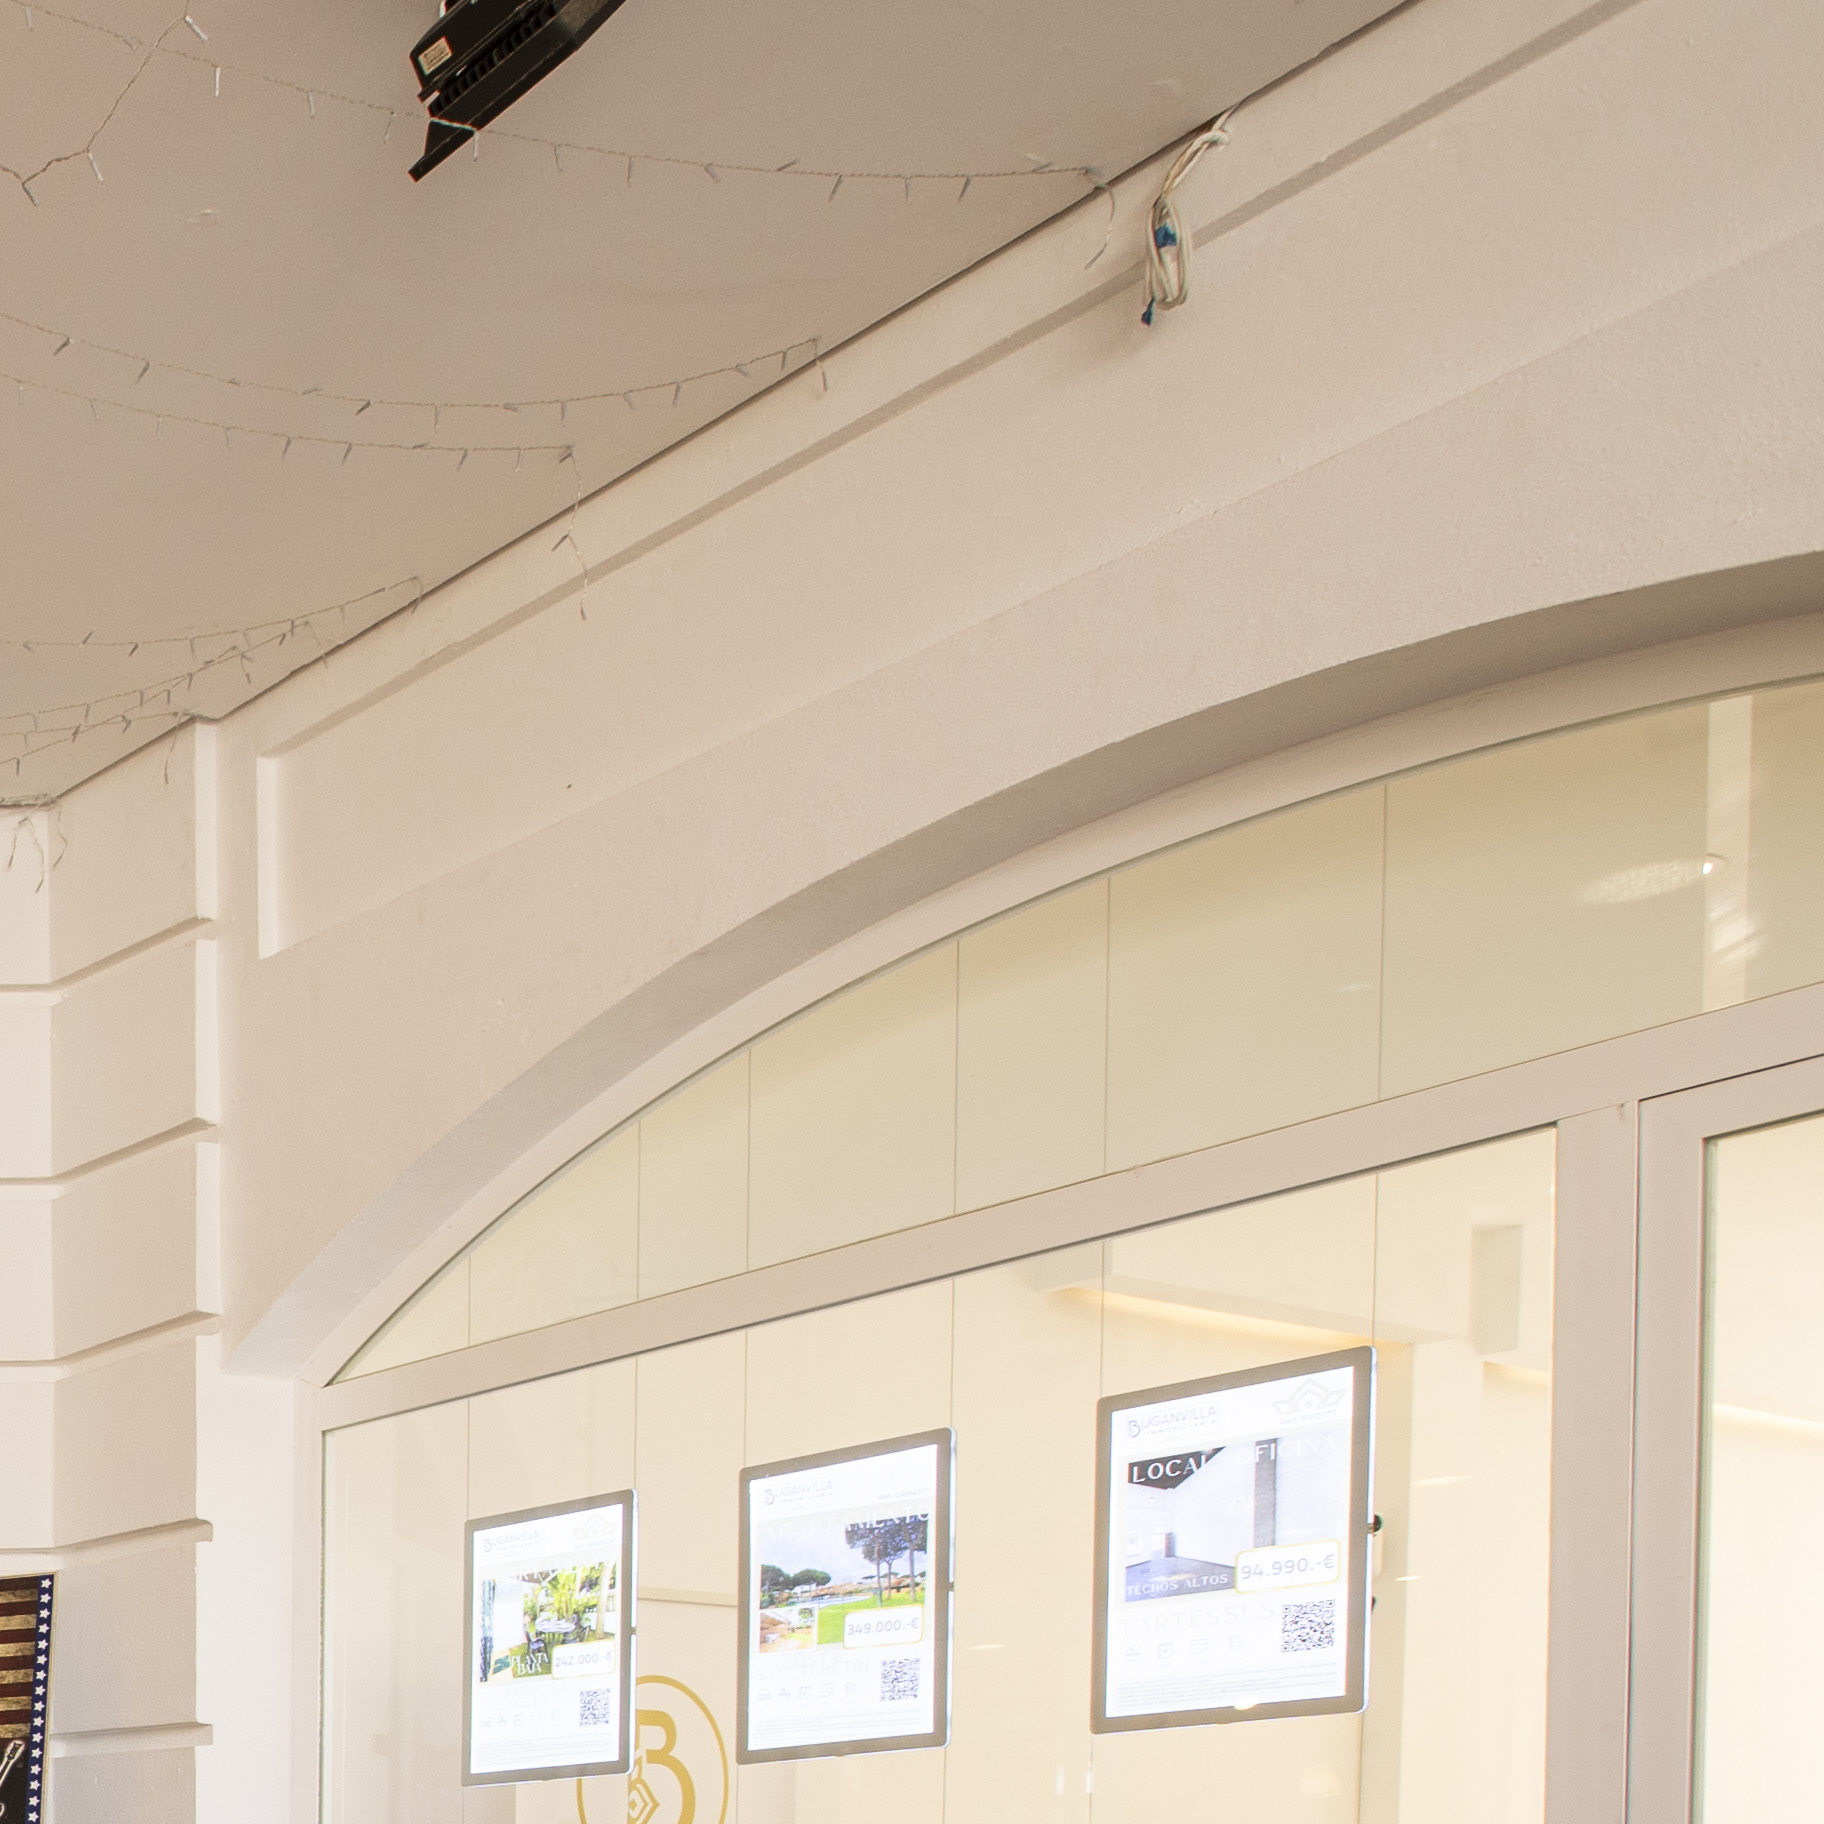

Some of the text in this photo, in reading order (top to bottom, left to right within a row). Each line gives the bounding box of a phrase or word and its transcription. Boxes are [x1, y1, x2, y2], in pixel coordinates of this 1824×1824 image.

[1133, 1452, 1214, 1483] LOCAL
[1240, 1553, 1337, 1580] 94.990.-€
[1126, 1573, 1228, 1597] TECHOS ALTOS
[846, 1617, 920, 1637] 349.000.-€
[554, 1651, 613, 1668] 242.000.-€
